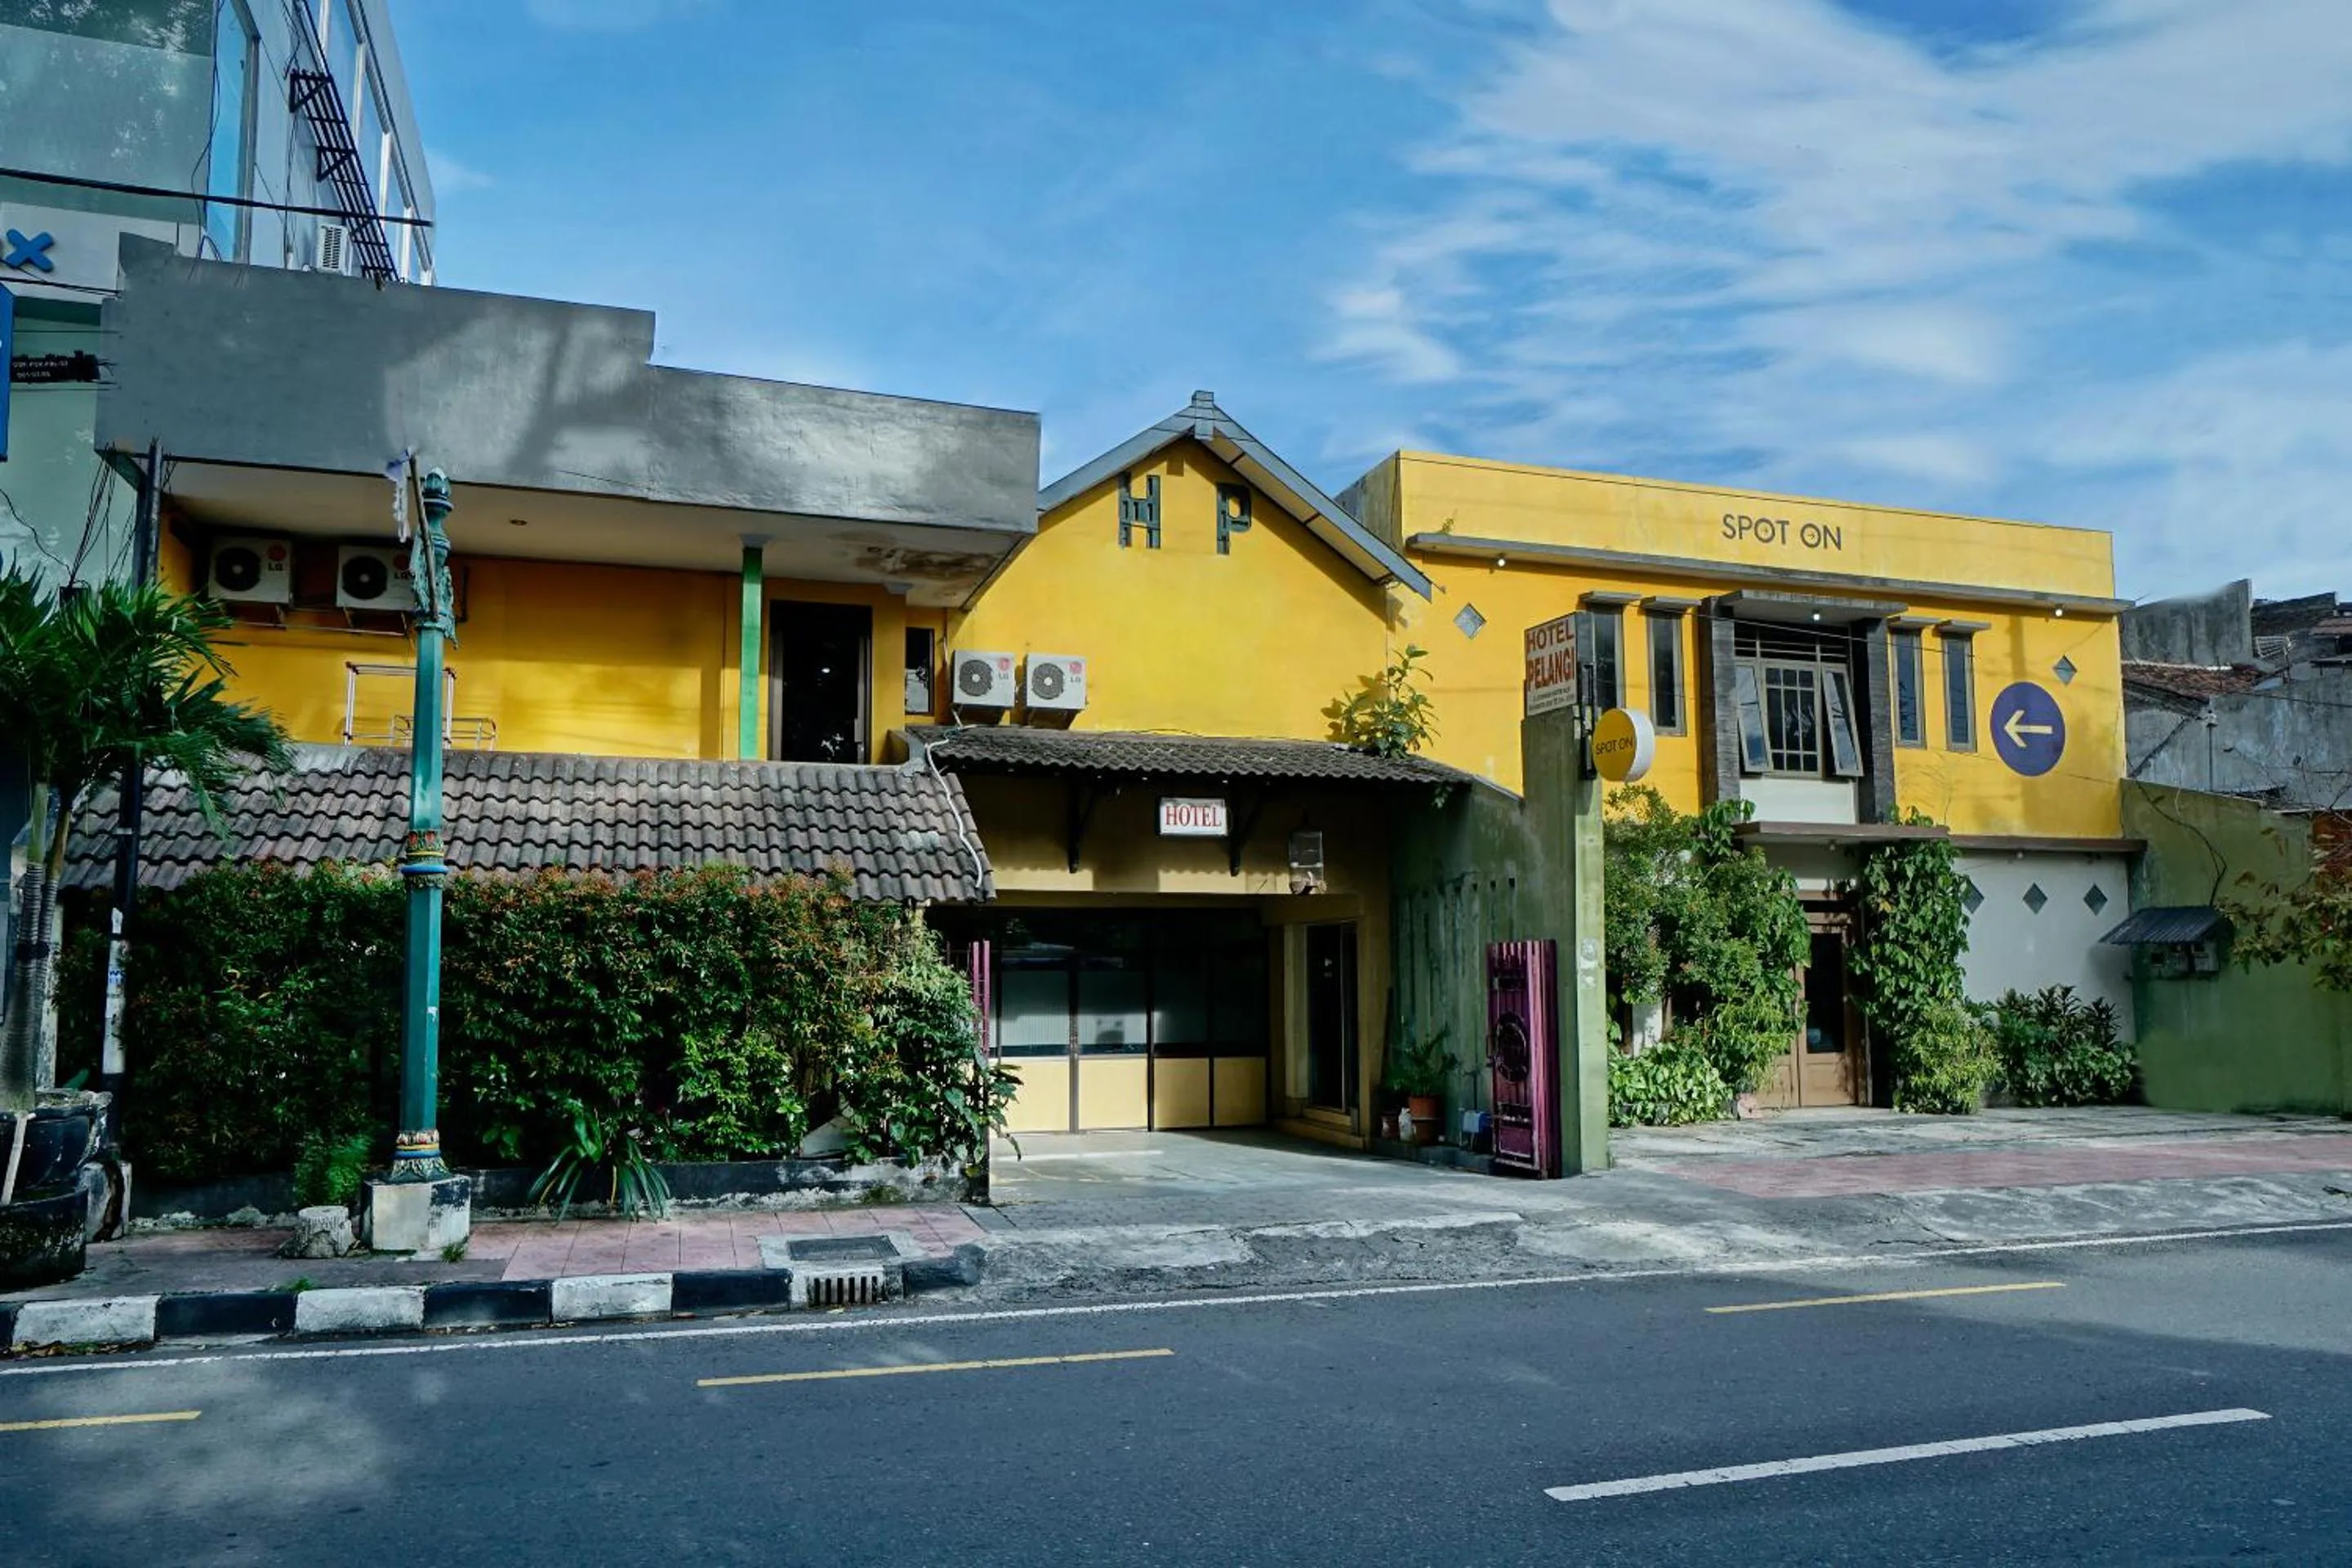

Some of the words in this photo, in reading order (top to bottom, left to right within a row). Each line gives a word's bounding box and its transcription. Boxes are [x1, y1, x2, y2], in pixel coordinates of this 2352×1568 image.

[1722, 514, 1790, 546] SPOT
[1800, 523, 1842, 550] ON
[1526, 618, 1575, 653] HOTEL
[1526, 646, 1575, 692] PELANGI
[1596, 739, 1617, 755] SPOT
[1619, 737, 1633, 751] ON
[1165, 804, 1223, 827] HOTEL
